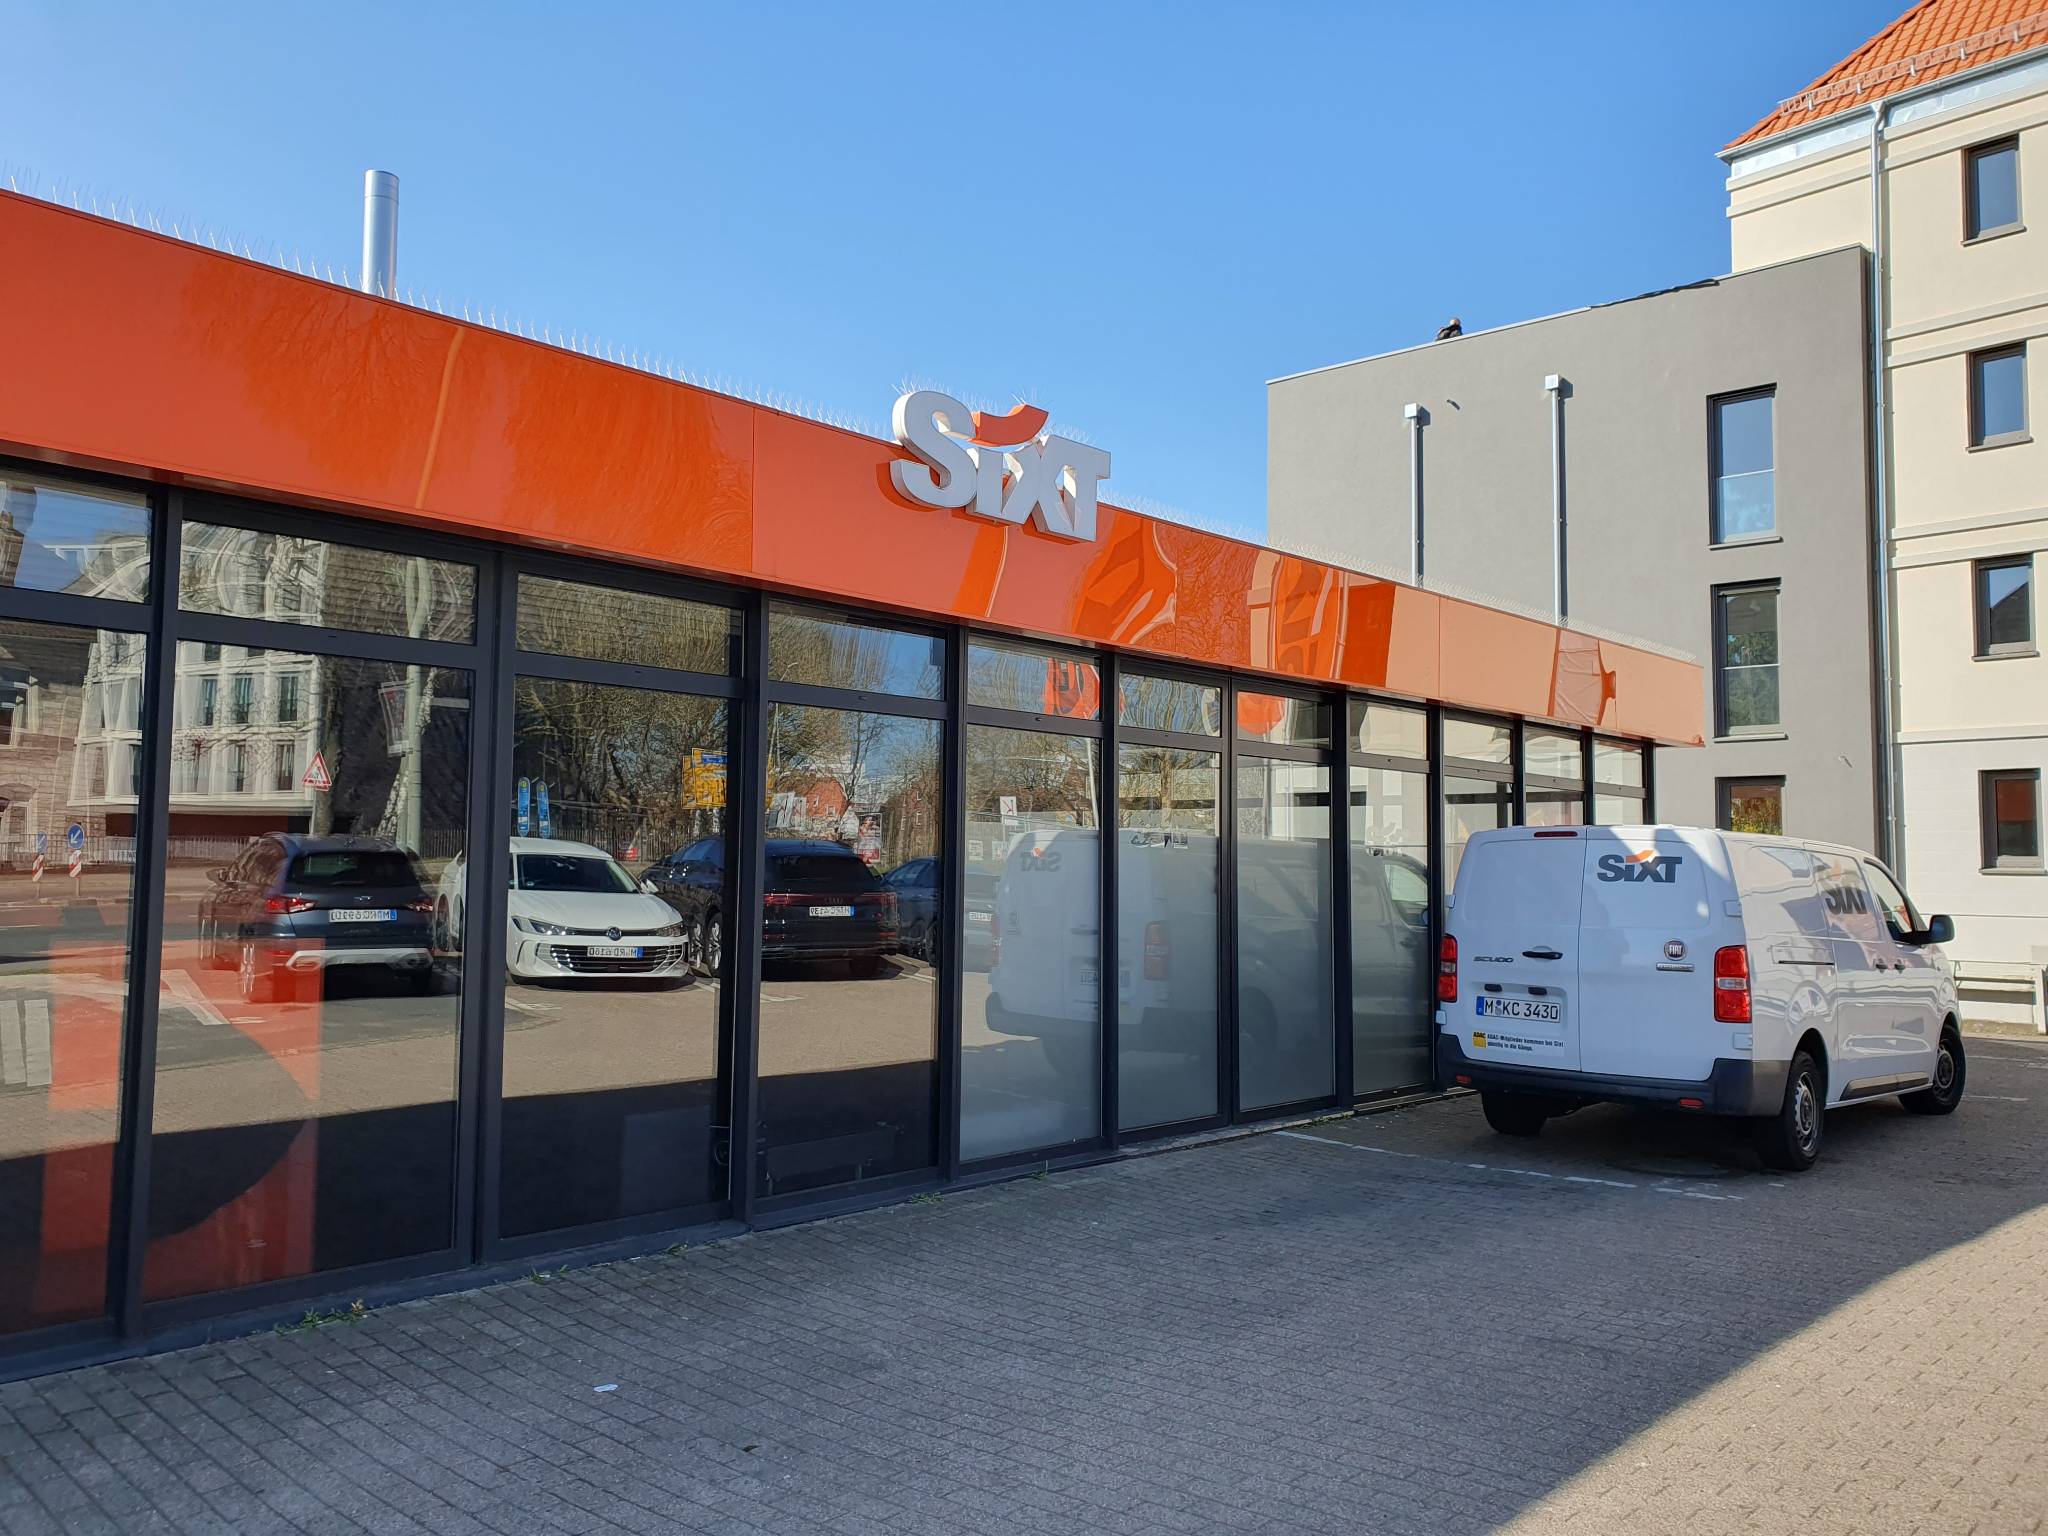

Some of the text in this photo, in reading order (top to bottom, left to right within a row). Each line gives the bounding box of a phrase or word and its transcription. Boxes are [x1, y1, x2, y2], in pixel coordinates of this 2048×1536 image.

[891, 390, 1111, 542] SIXT
[1597, 850, 1682, 883] SIXT
[1669, 944, 1682, 955] FIAT
[1523, 1003, 1558, 1020] 3430
